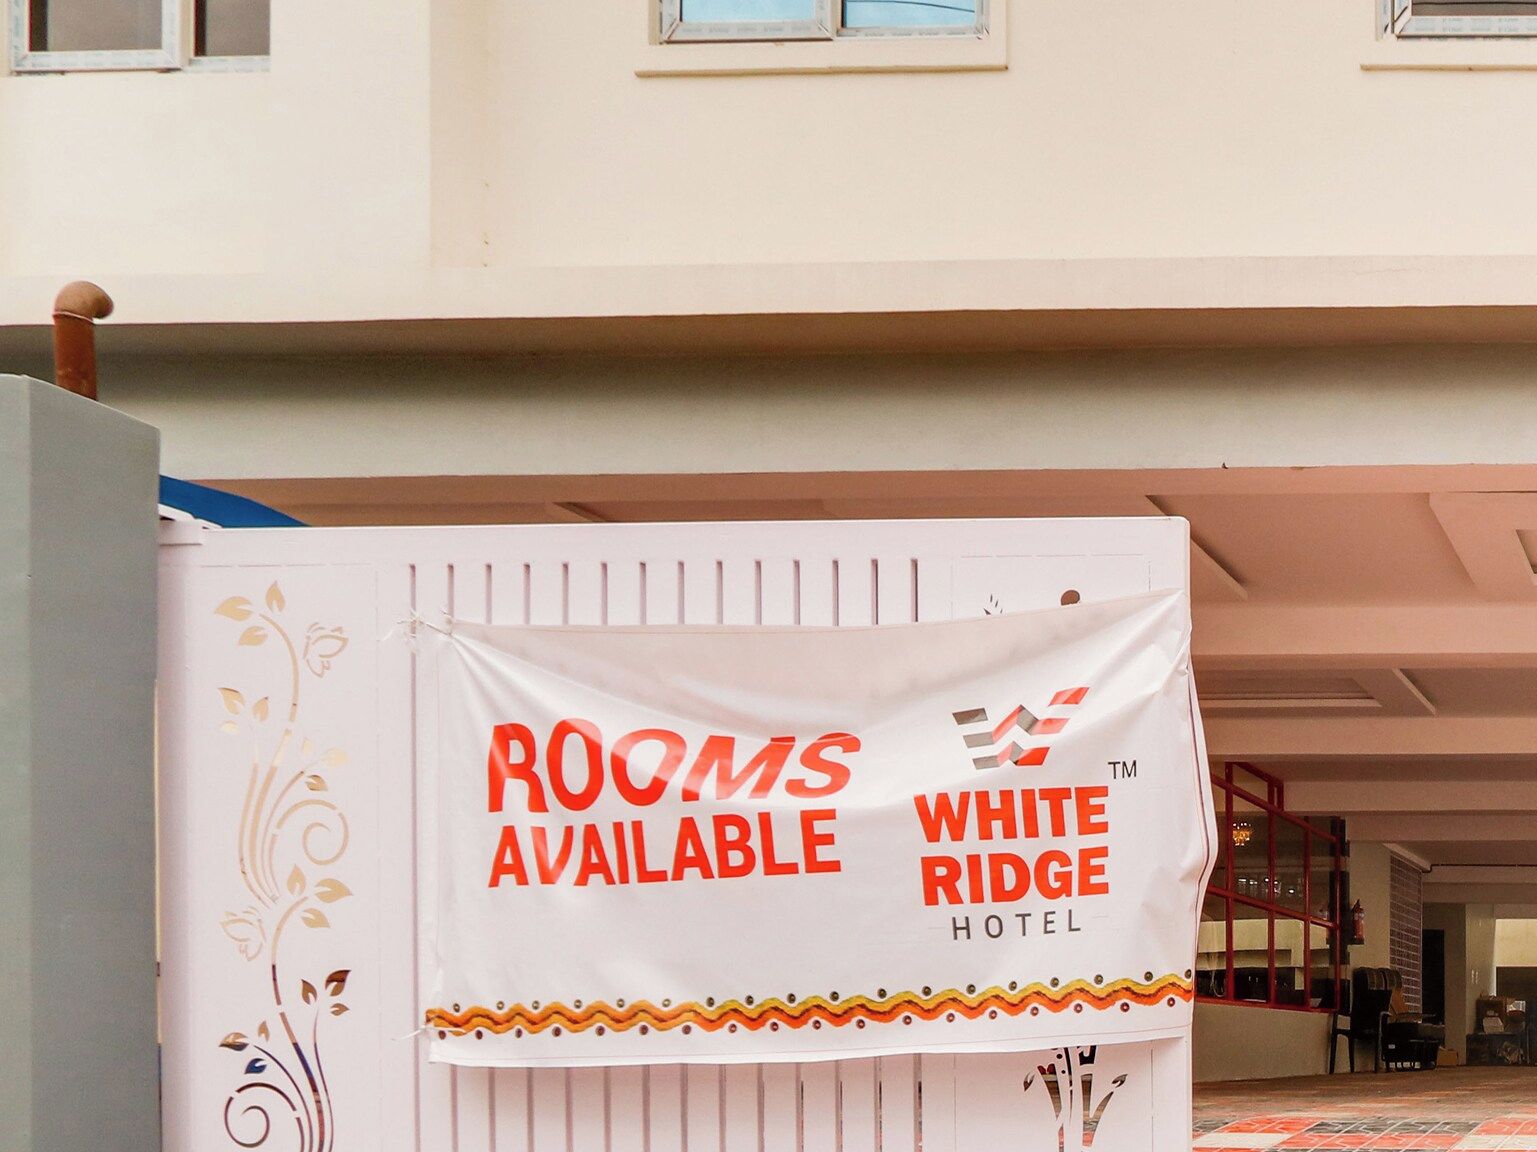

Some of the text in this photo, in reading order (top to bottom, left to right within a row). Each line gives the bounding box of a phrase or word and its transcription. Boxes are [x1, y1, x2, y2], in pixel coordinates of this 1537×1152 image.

[488, 719, 861, 813] ROOMS
[1107, 759, 1137, 780] TM
[914, 785, 1110, 844] WHITE
[488, 809, 842, 888] AVAILABLE
[921, 845, 1110, 907] RIDGE
[951, 908, 1082, 941] HOTEL
